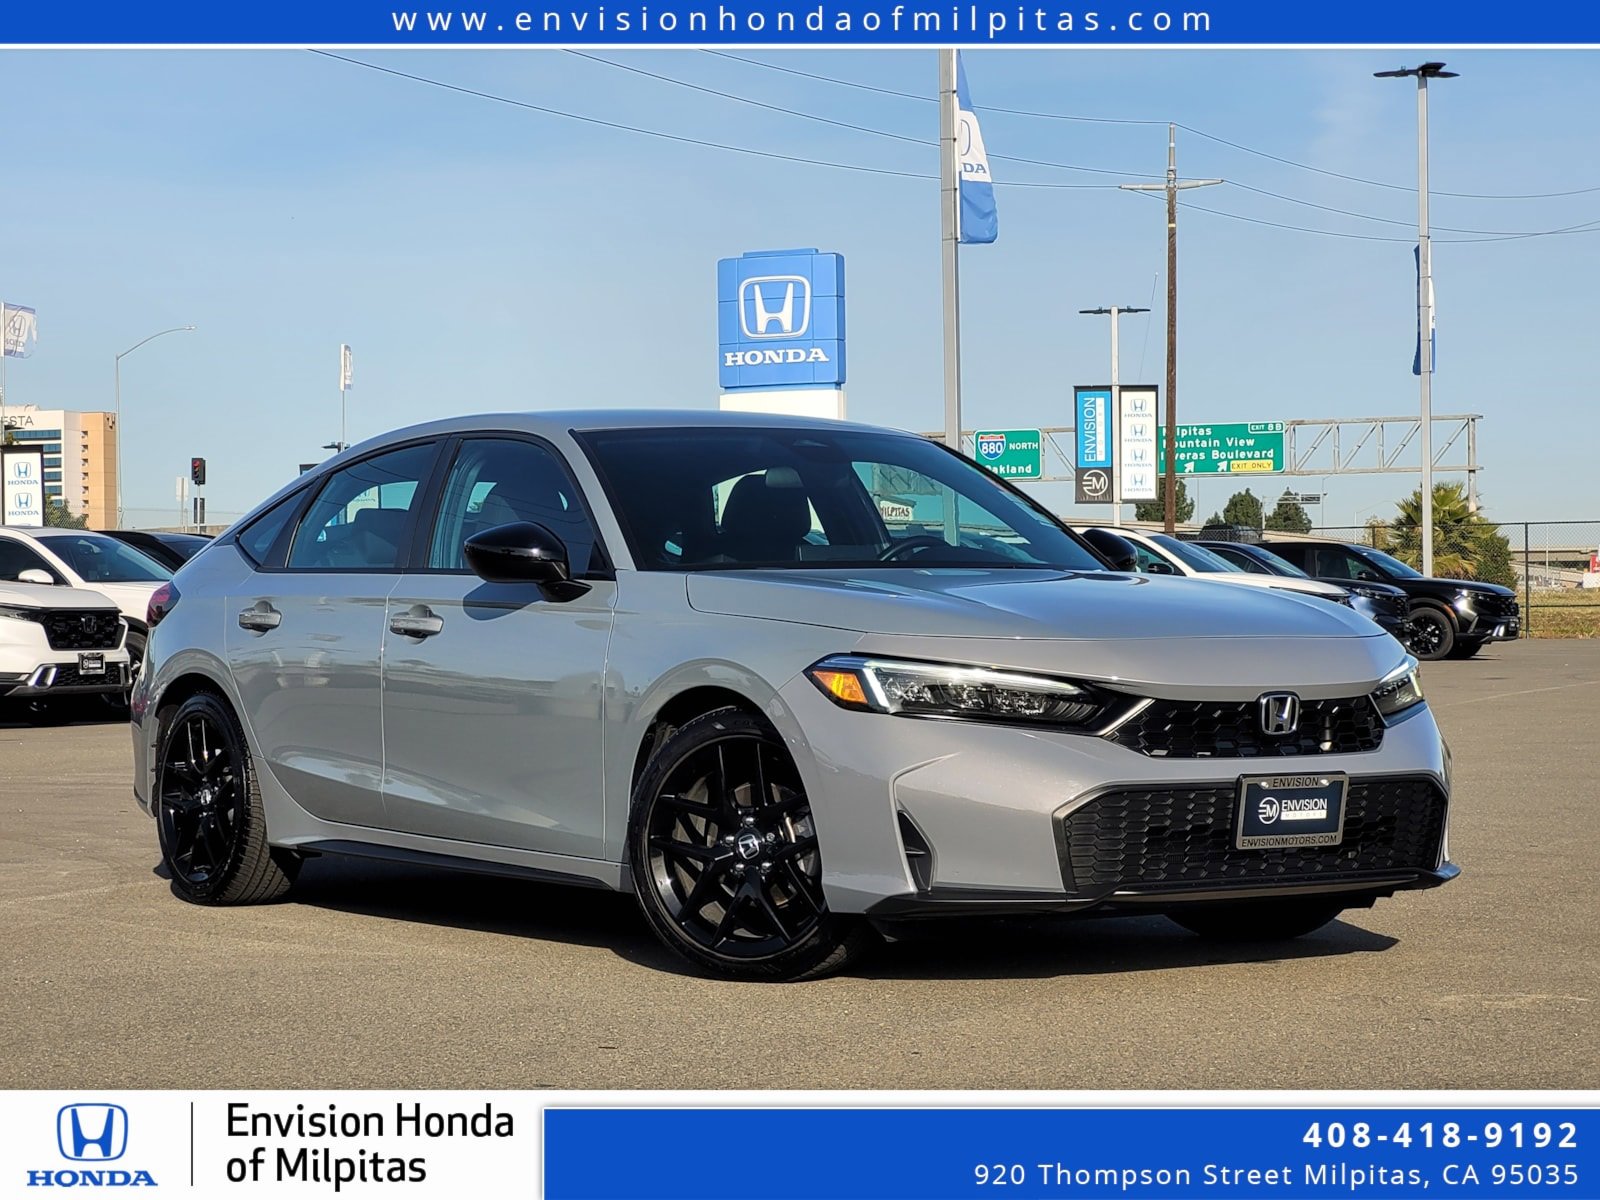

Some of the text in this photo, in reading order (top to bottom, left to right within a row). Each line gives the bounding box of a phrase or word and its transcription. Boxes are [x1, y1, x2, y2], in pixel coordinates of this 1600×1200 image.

[724, 346, 829, 367] HONDA
[1, 415, 34, 426] ESTA
[1083, 397, 1096, 462] ENVISION
[1162, 427, 1212, 439] lpitas
[981, 442, 1039, 454] 880 NORTH
[1162, 437, 1255, 449] ountain View
[1211, 448, 1274, 460] Boulevard
[1273, 777, 1319, 788] ENVISION
[1281, 798, 1328, 811] ENVISION
[1241, 835, 1337, 848] ENVISIONMOTORS.COM
